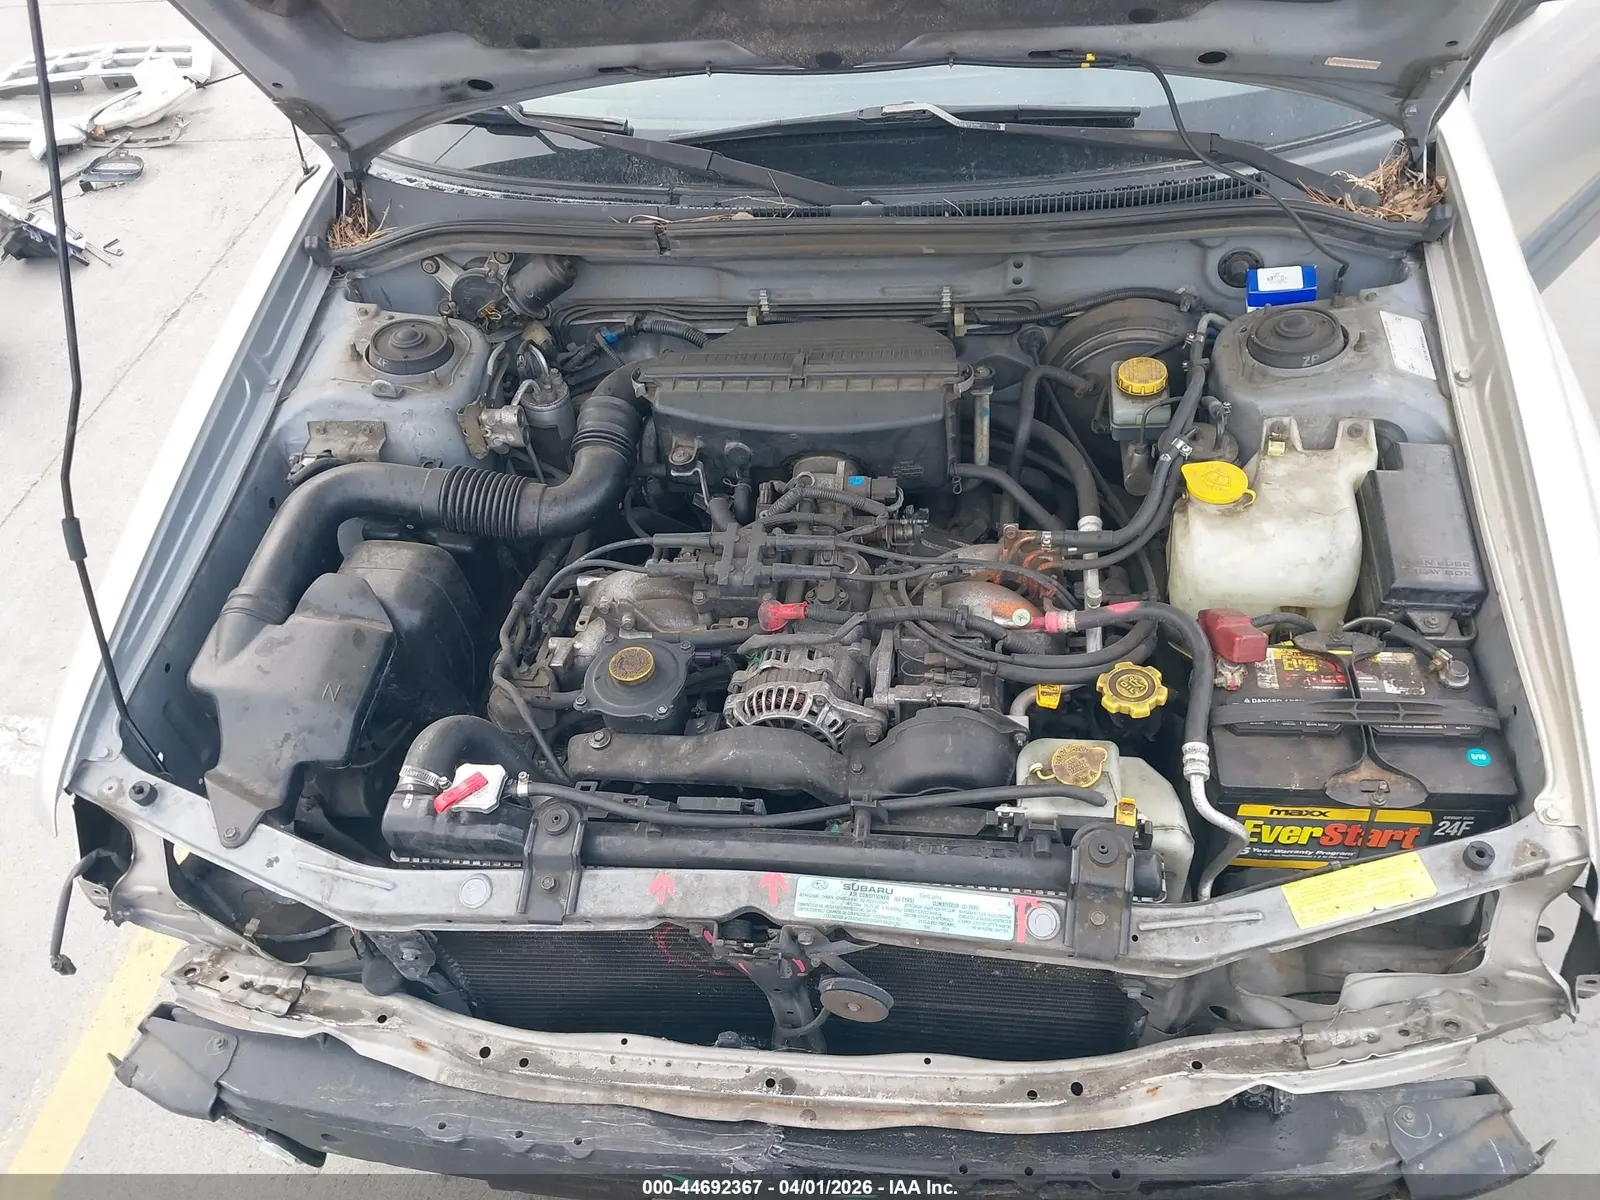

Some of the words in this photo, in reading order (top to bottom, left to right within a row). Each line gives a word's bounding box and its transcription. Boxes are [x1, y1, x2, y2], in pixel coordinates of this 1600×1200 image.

[1120, 682, 1135, 694] OIL
[1269, 808, 1331, 817] maxx
[1243, 819, 1420, 850] EverStart
[1433, 820, 1475, 836] 24F
[843, 882, 894, 895] SUBARU
